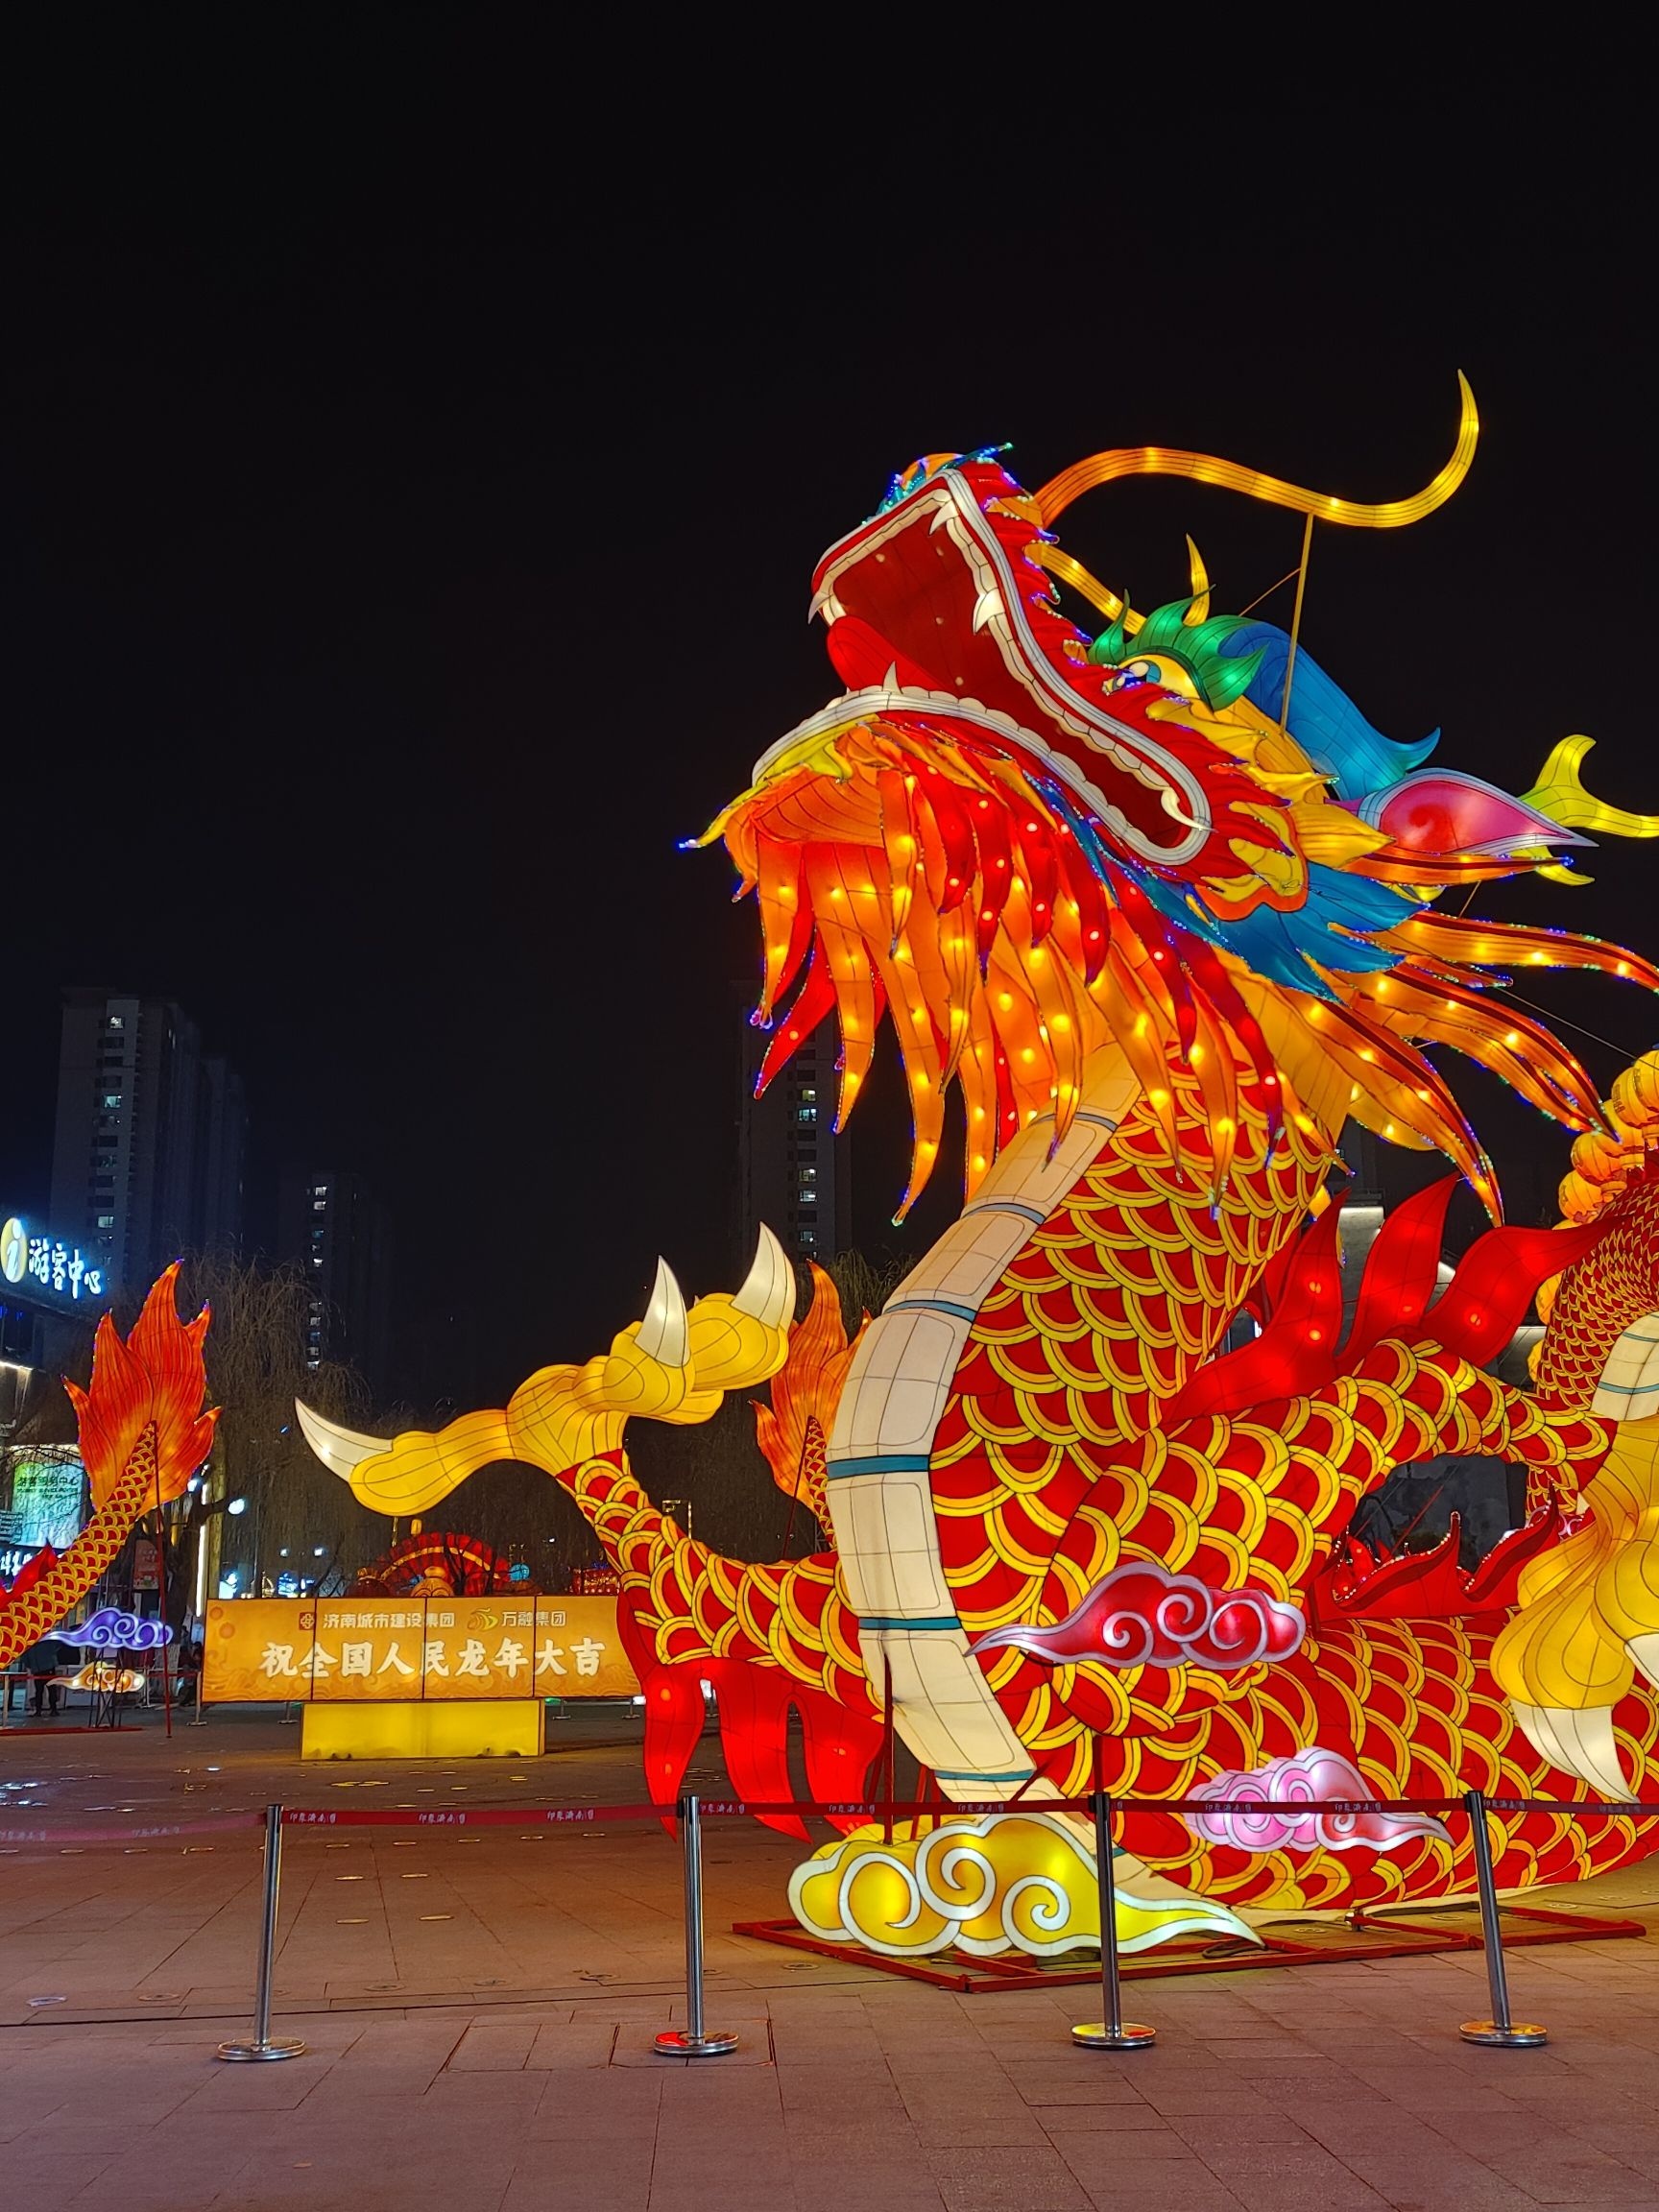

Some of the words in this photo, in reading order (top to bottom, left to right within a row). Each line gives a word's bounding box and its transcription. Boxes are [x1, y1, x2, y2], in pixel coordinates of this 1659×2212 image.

[29, 1238, 102, 1299] 游客中心
[323, 1612, 456, 1629] 济南城市建设集团
[501, 1611, 567, 1628] 万融集团
[258, 1637, 606, 1679] 祝全国人民龙年大吉
